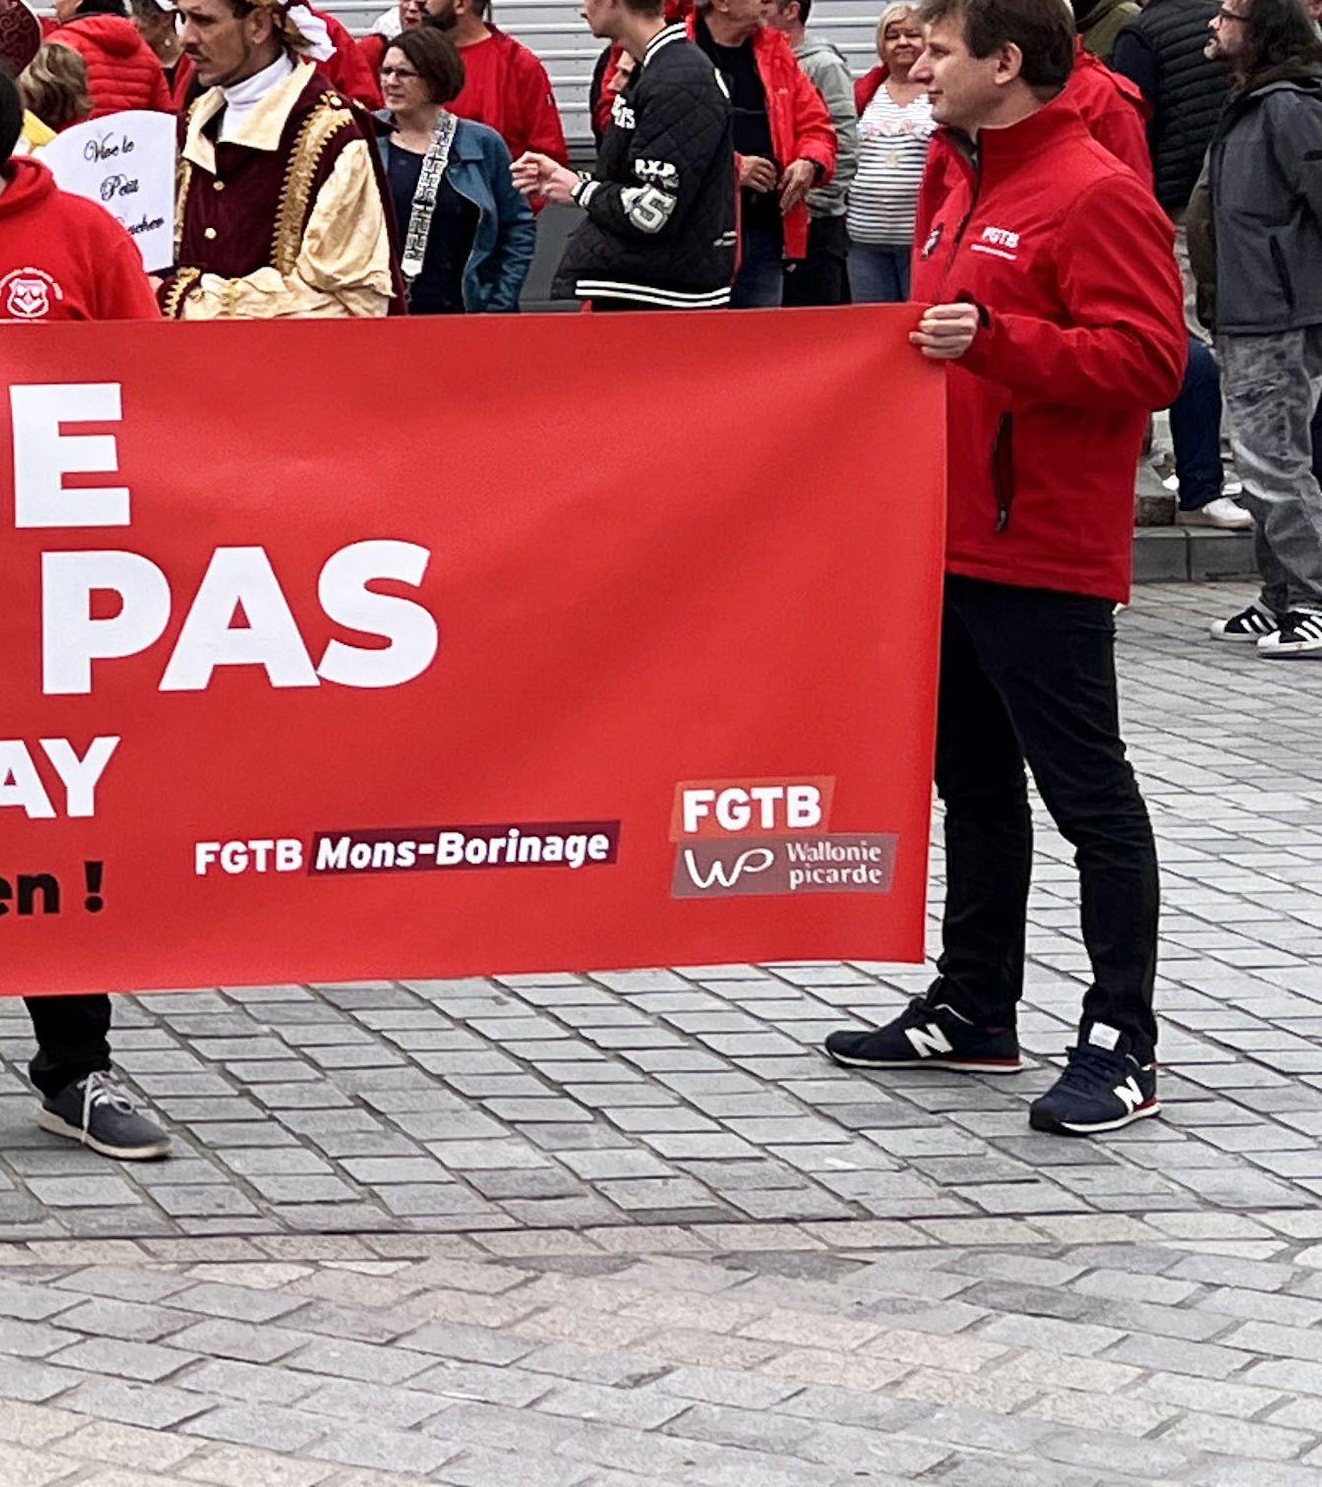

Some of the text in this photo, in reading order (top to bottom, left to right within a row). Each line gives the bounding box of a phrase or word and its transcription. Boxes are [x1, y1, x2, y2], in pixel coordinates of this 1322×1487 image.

[41, 539, 439, 696] PAS
[683, 784, 822, 833] FGTB
[195, 828, 610, 875] FGTB Mons-Borinage
[786, 840, 883, 863] Wallonie
[83, 860, 104, 913] !
[789, 863, 883, 891] picarde
